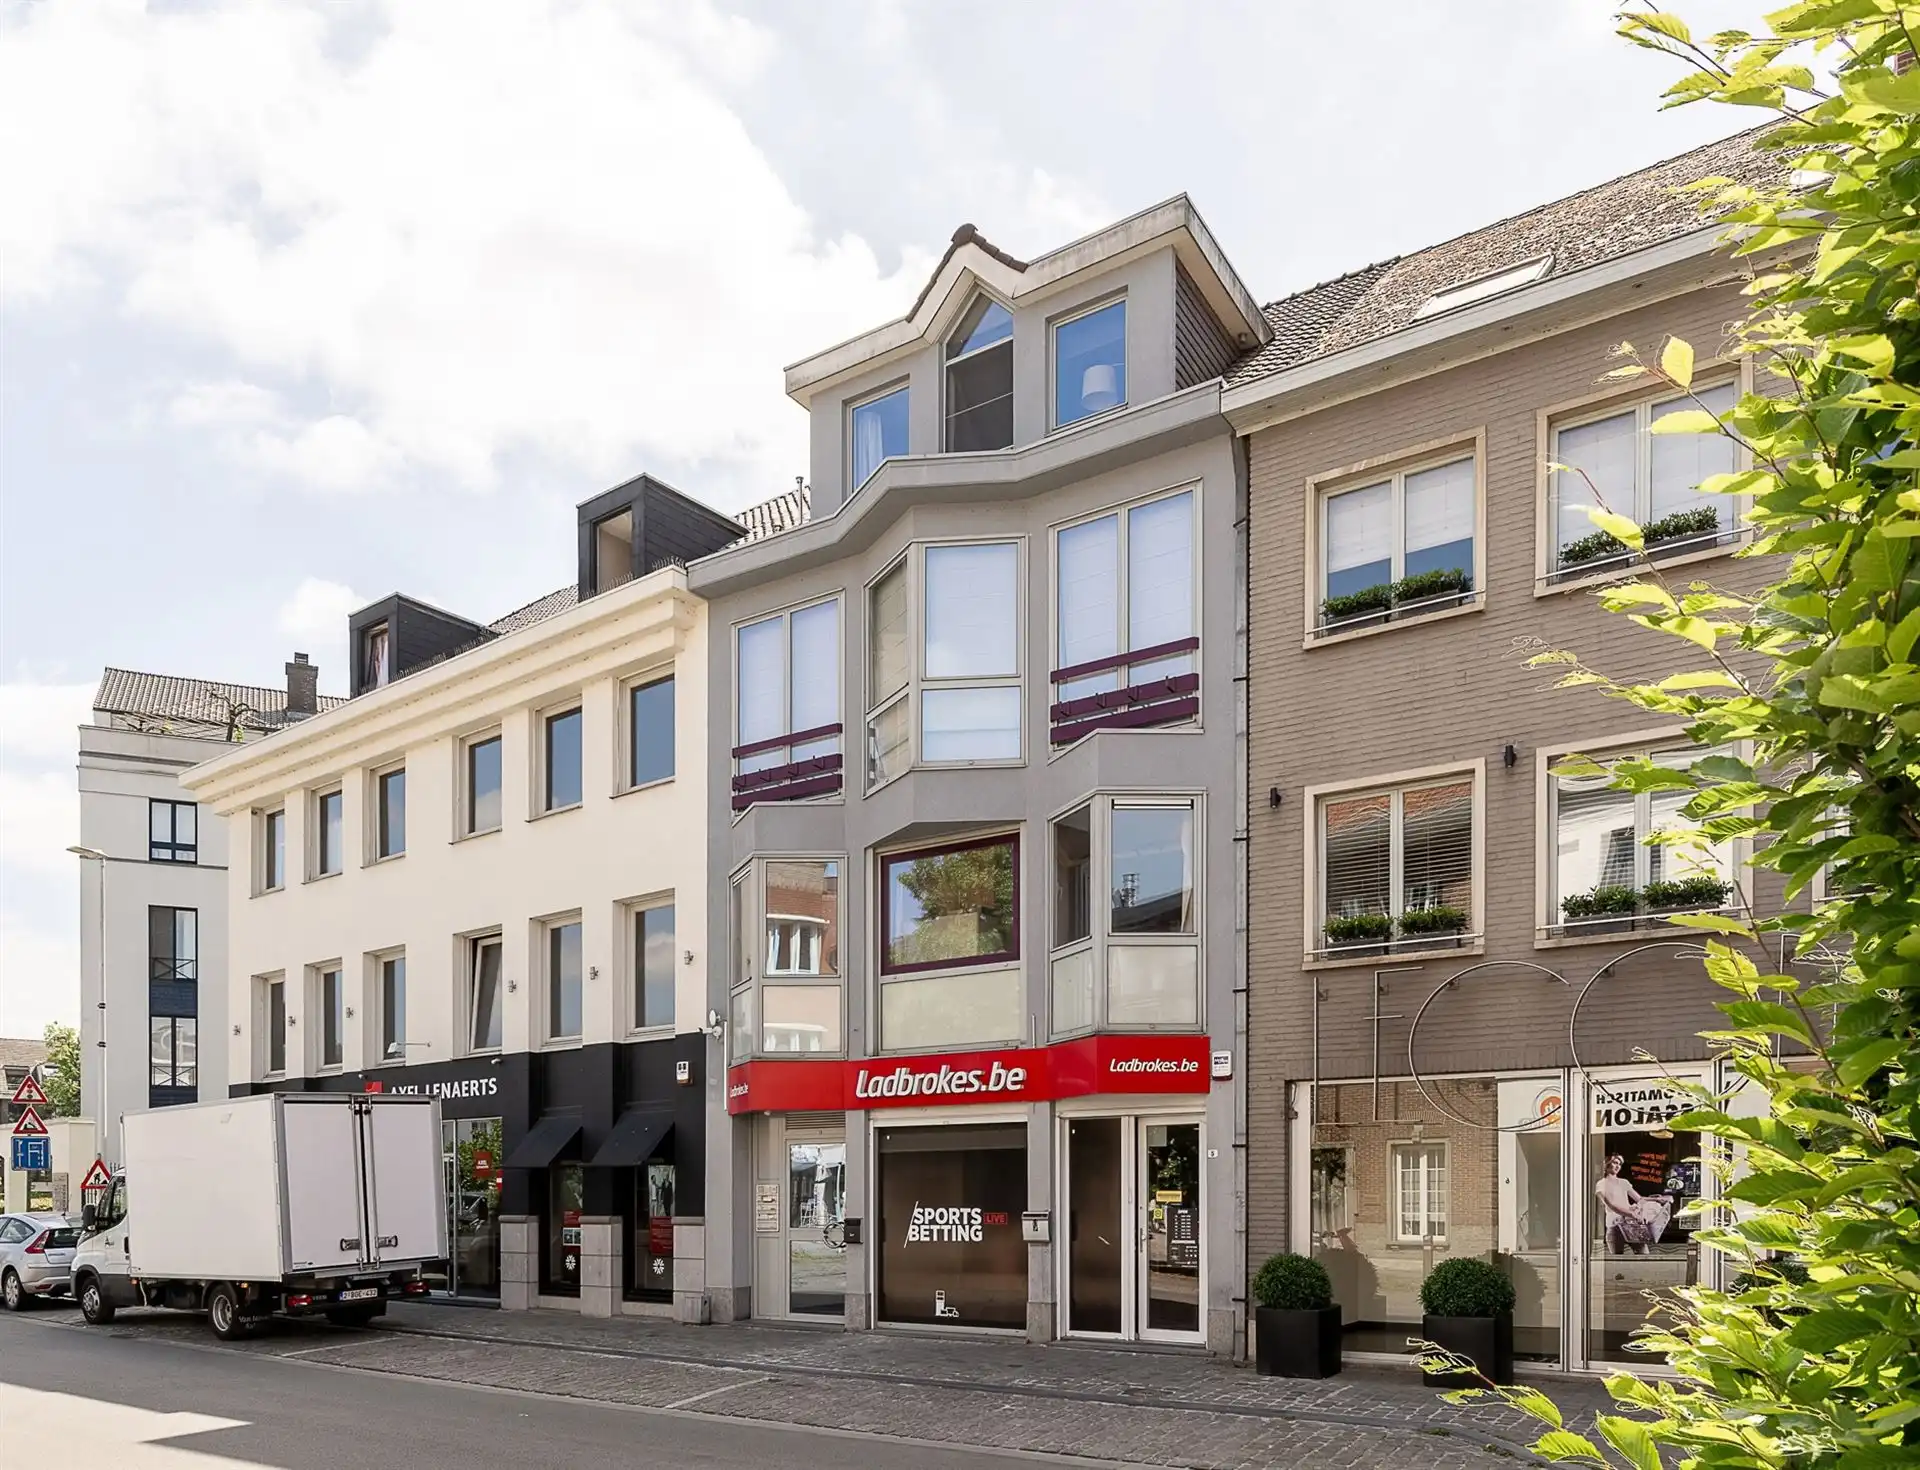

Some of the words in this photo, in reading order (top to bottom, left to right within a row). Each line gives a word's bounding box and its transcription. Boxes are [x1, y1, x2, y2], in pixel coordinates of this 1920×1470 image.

[1109, 1058, 1199, 1072] Ladbrokes.be
[425, 1077, 498, 1099] LENAERTS
[855, 1061, 1027, 1098] Ladbrokes.be
[913, 1207, 982, 1225] SPORTS
[986, 1214, 1005, 1223] LIVE
[908, 1224, 983, 1242] BETTING
